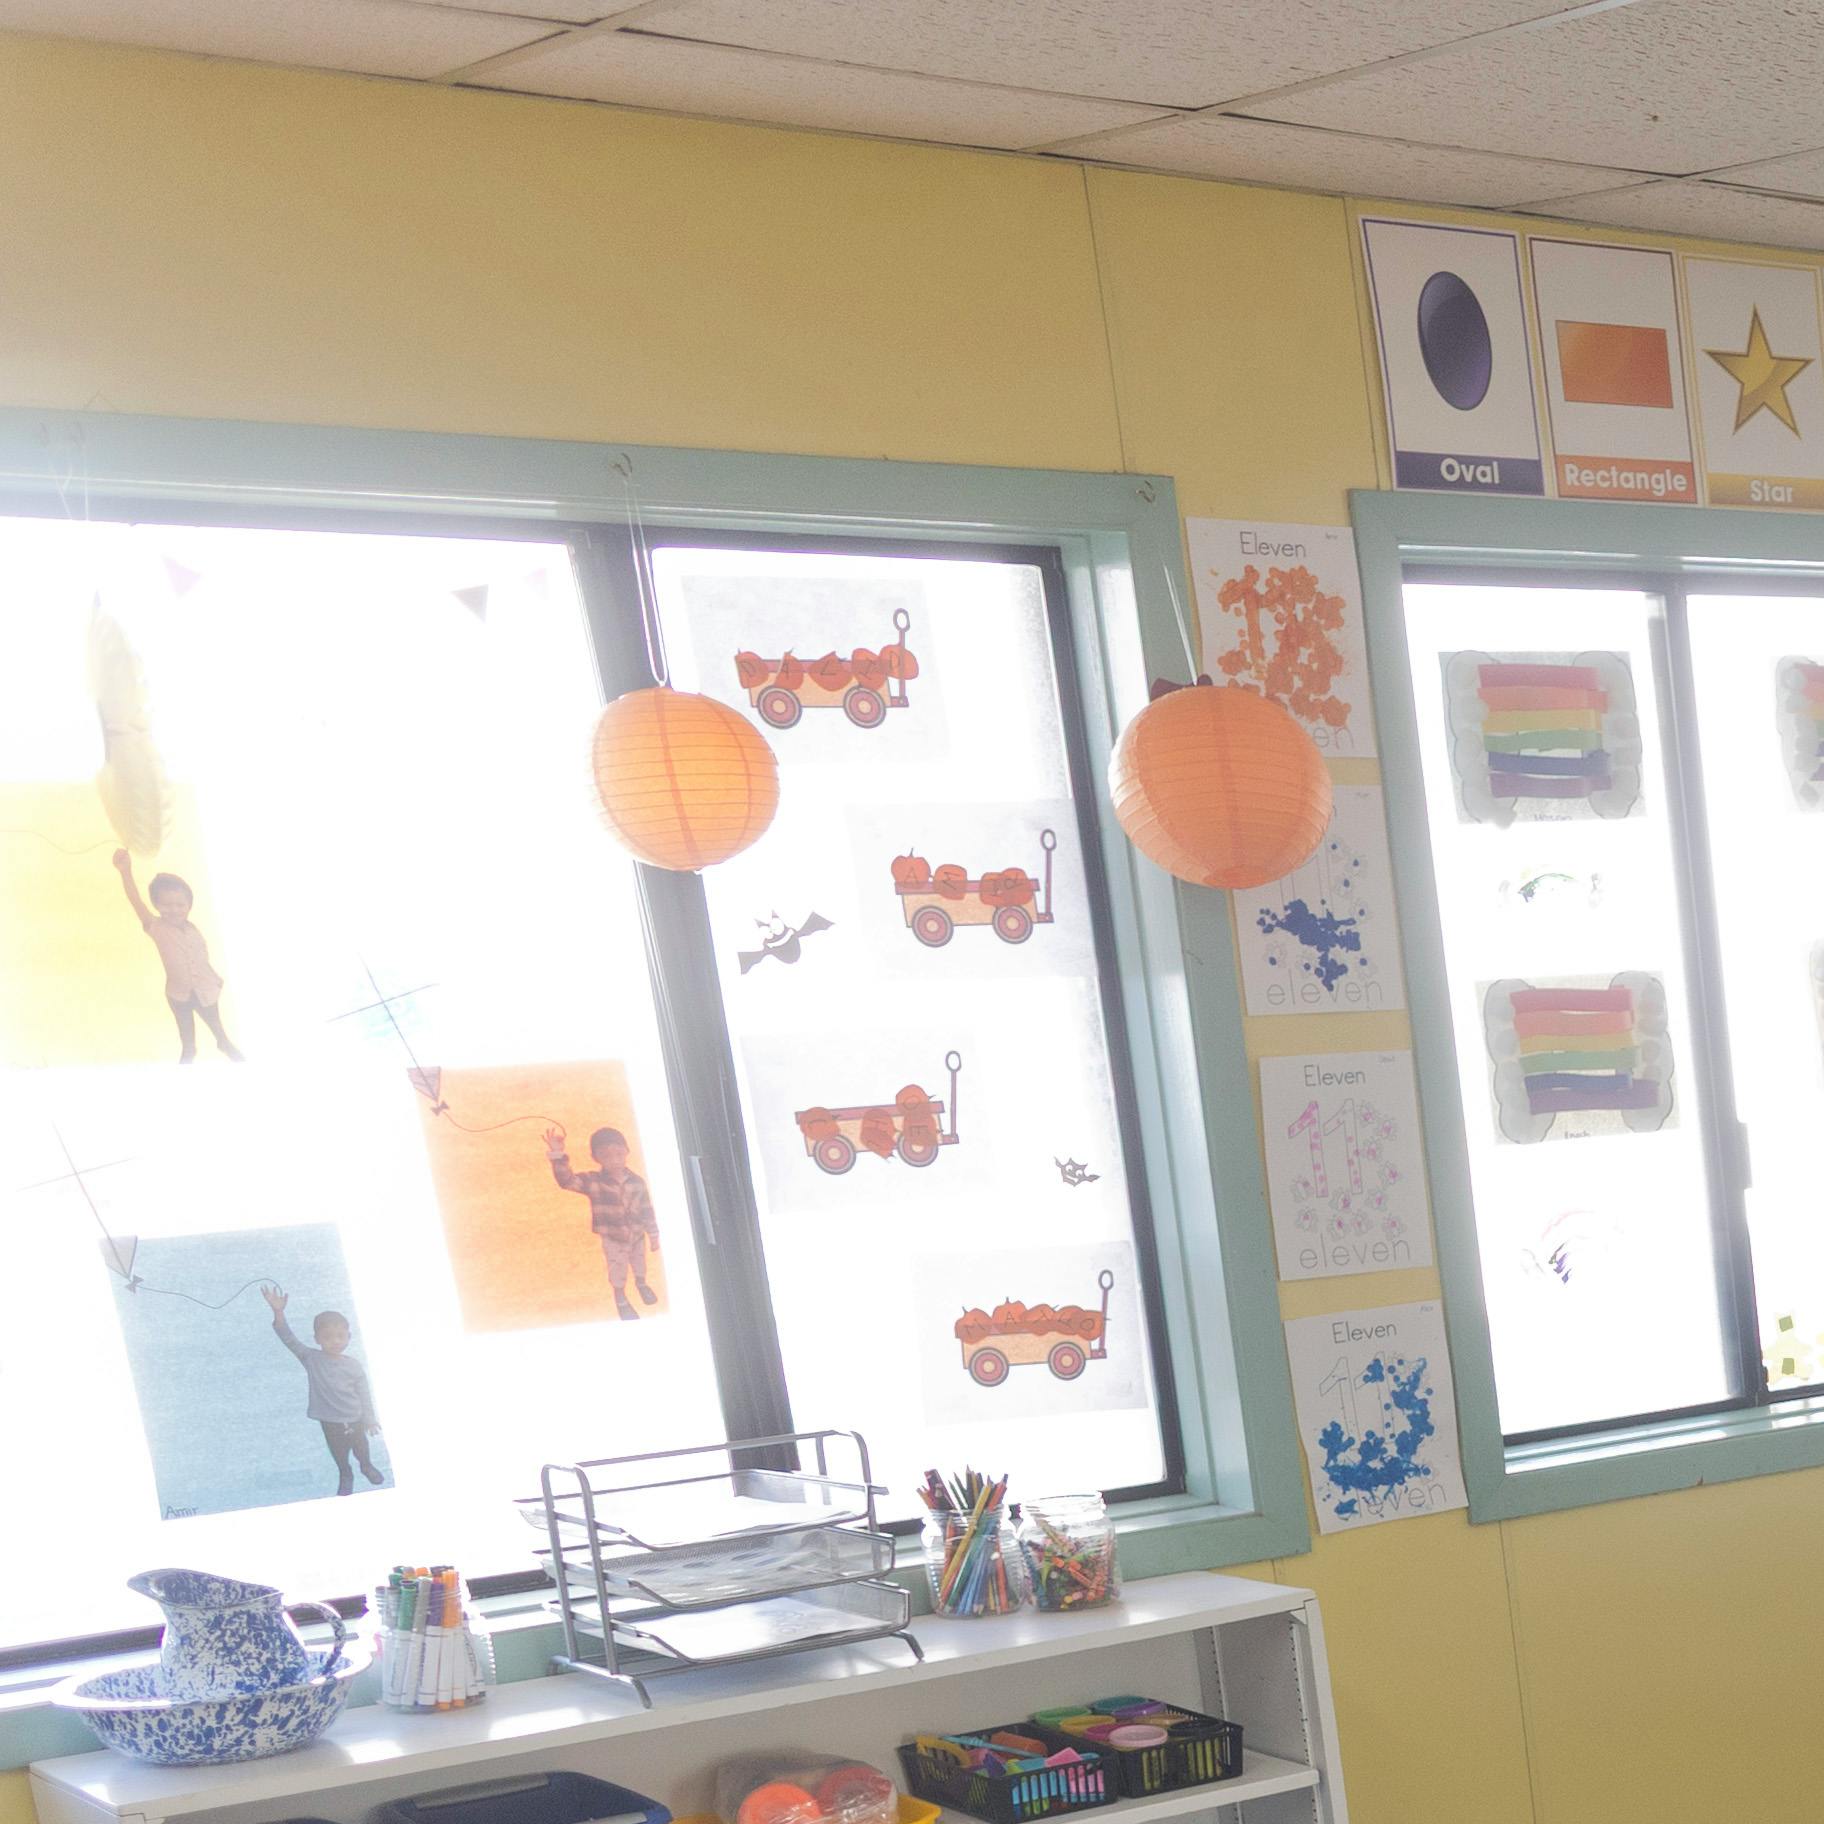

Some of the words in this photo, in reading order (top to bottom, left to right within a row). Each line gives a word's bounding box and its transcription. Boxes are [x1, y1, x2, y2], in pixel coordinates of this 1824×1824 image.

[1440, 458, 1500, 485] Oval
[1565, 464, 1688, 496] Rectangle
[1750, 479, 1794, 503] Star
[1240, 532, 1306, 557] Eleven
[1304, 1064, 1366, 1088] Eleven
[1300, 1233, 1411, 1270] eleven
[1333, 1321, 1397, 1344] Eleven
